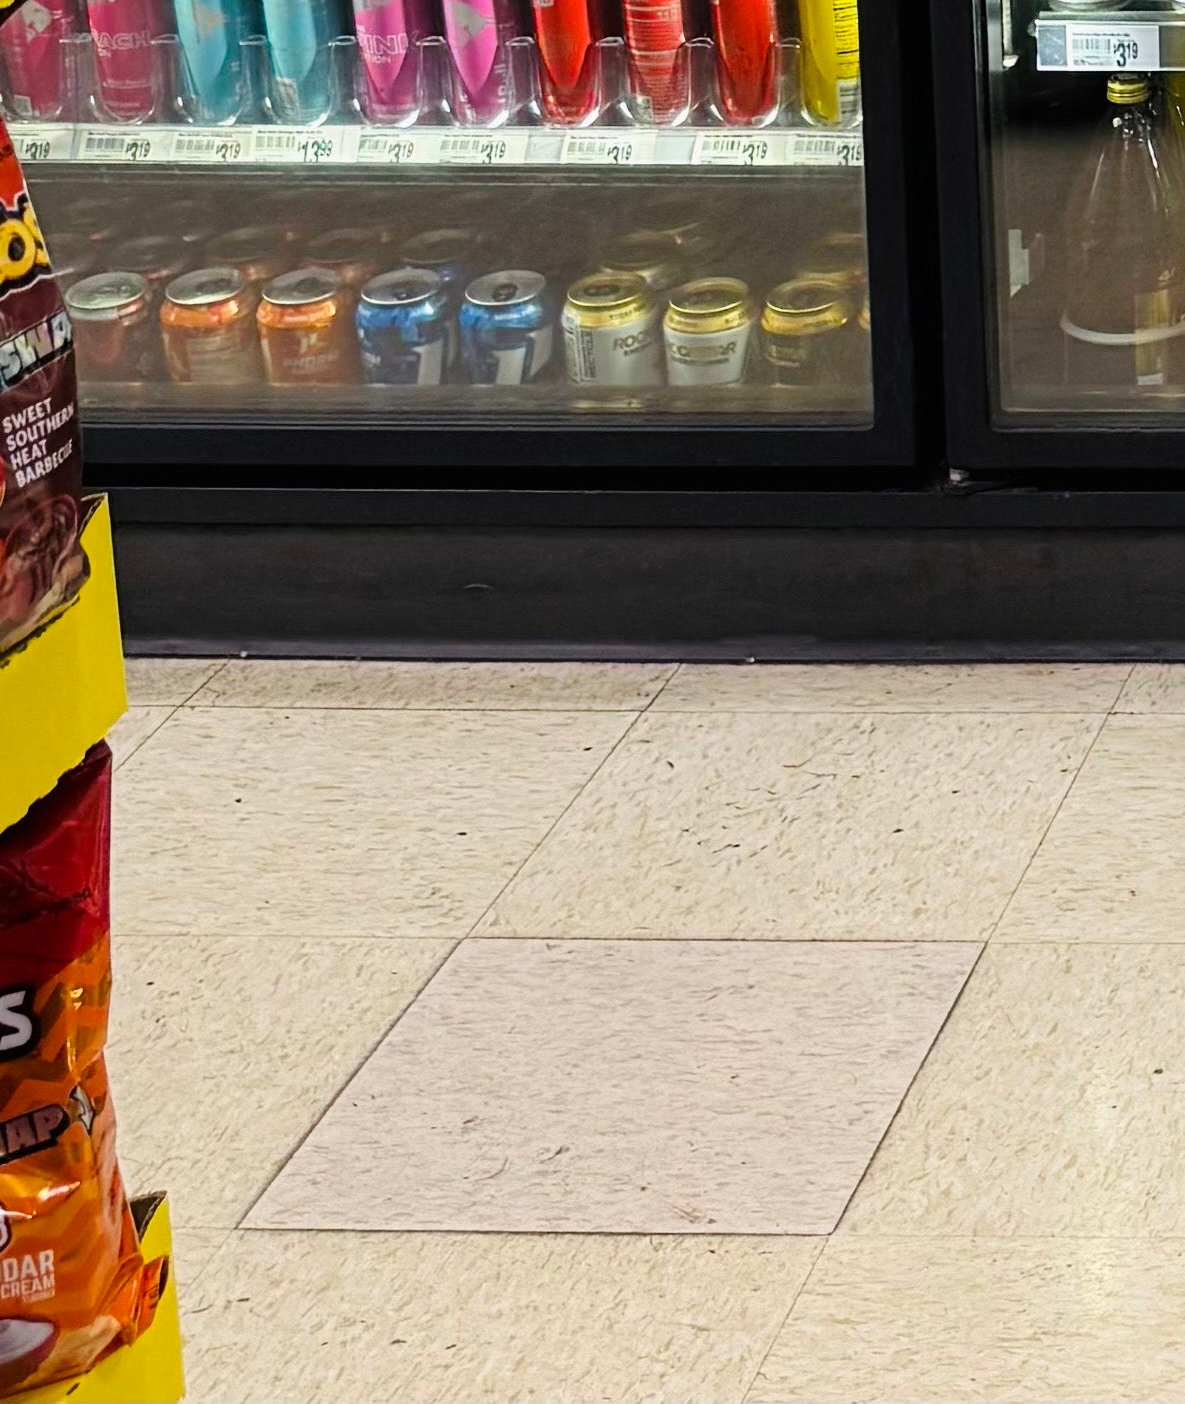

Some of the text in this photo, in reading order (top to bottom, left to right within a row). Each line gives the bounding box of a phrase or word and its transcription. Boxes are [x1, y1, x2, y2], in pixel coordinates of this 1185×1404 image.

[3, 398, 52, 434] SWEET
[7, 401, 75, 452] SOUTHERN
[11, 439, 48, 470] HEAT
[15, 438, 73, 488] BARBECUE
